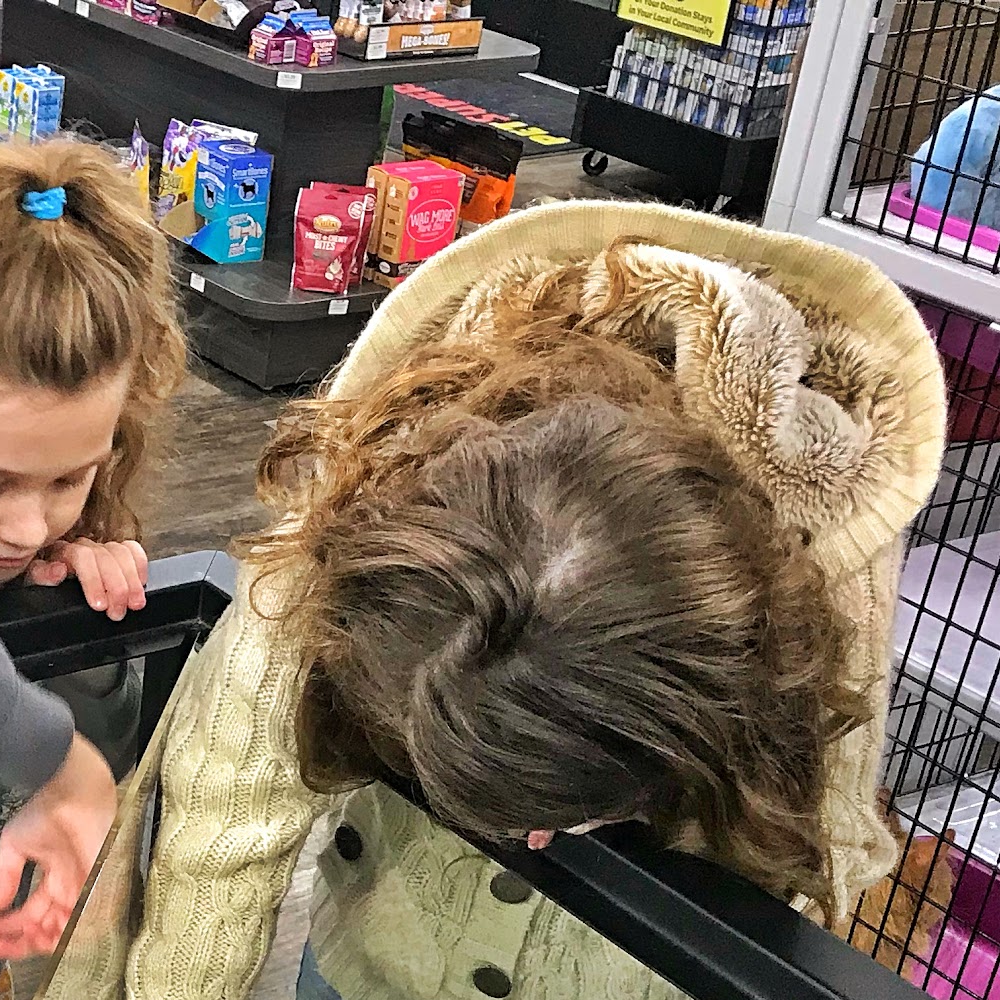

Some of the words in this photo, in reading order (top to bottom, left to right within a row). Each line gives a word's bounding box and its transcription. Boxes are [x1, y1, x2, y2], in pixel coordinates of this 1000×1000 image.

[628, 4, 636, 14] in
[637, 8, 652, 19] Your
[653, 12, 672, 25] Local
[672, 18, 715, 39] Community
[660, 2, 692, 18] Donation
[693, 11, 713, 25] Stays
[410, 210, 430, 227] WAG
[431, 208, 455, 223] MORE
[314, 240, 336, 251] BITES
